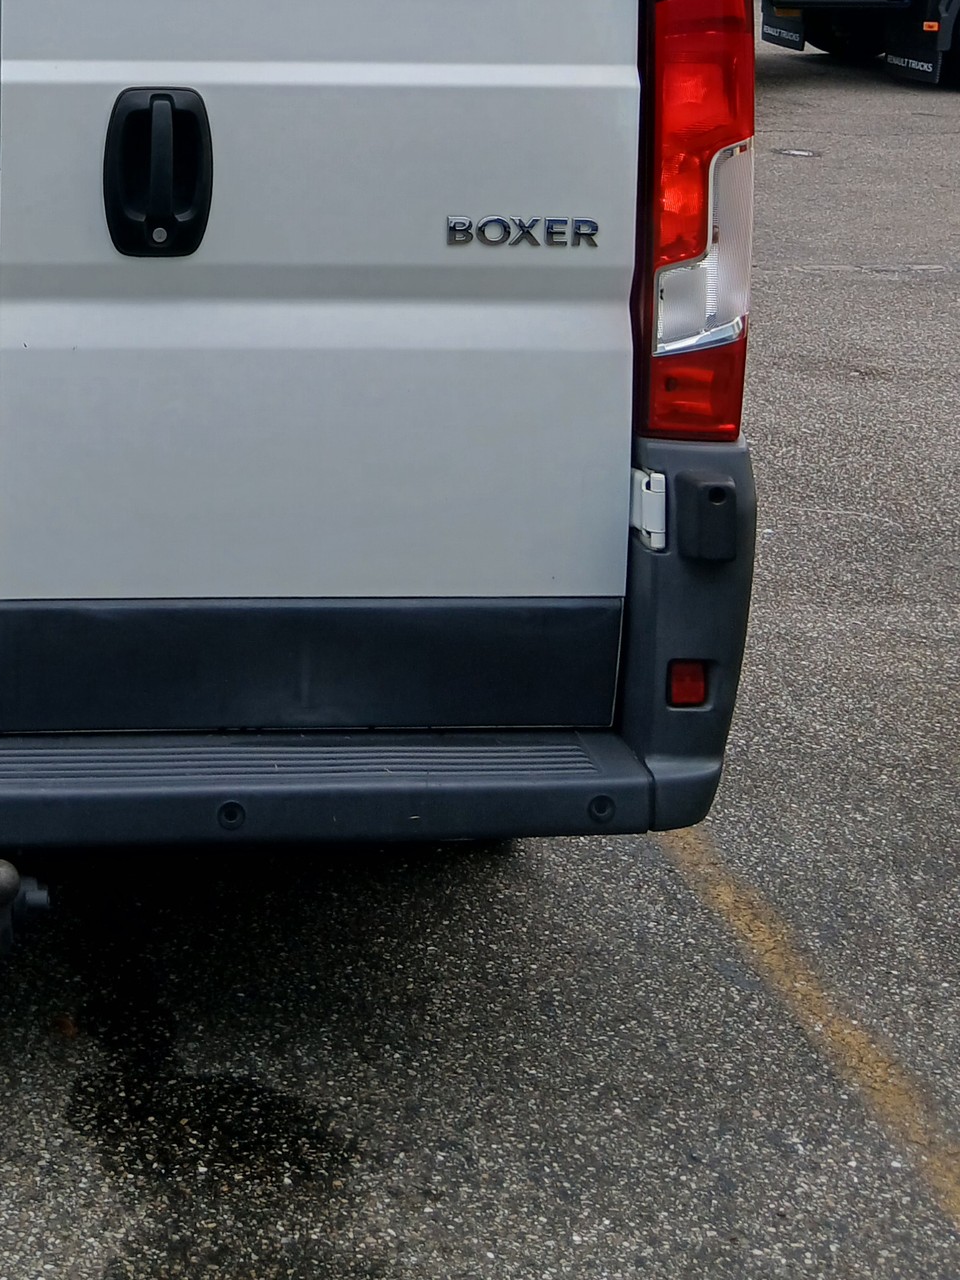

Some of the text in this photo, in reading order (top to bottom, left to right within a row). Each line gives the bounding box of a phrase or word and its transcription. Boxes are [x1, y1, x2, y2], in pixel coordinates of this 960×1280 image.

[780, 28, 800, 42] TRUCKS
[908, 59, 933, 73] TRUCKS
[446, 215, 599, 247] BOXER
